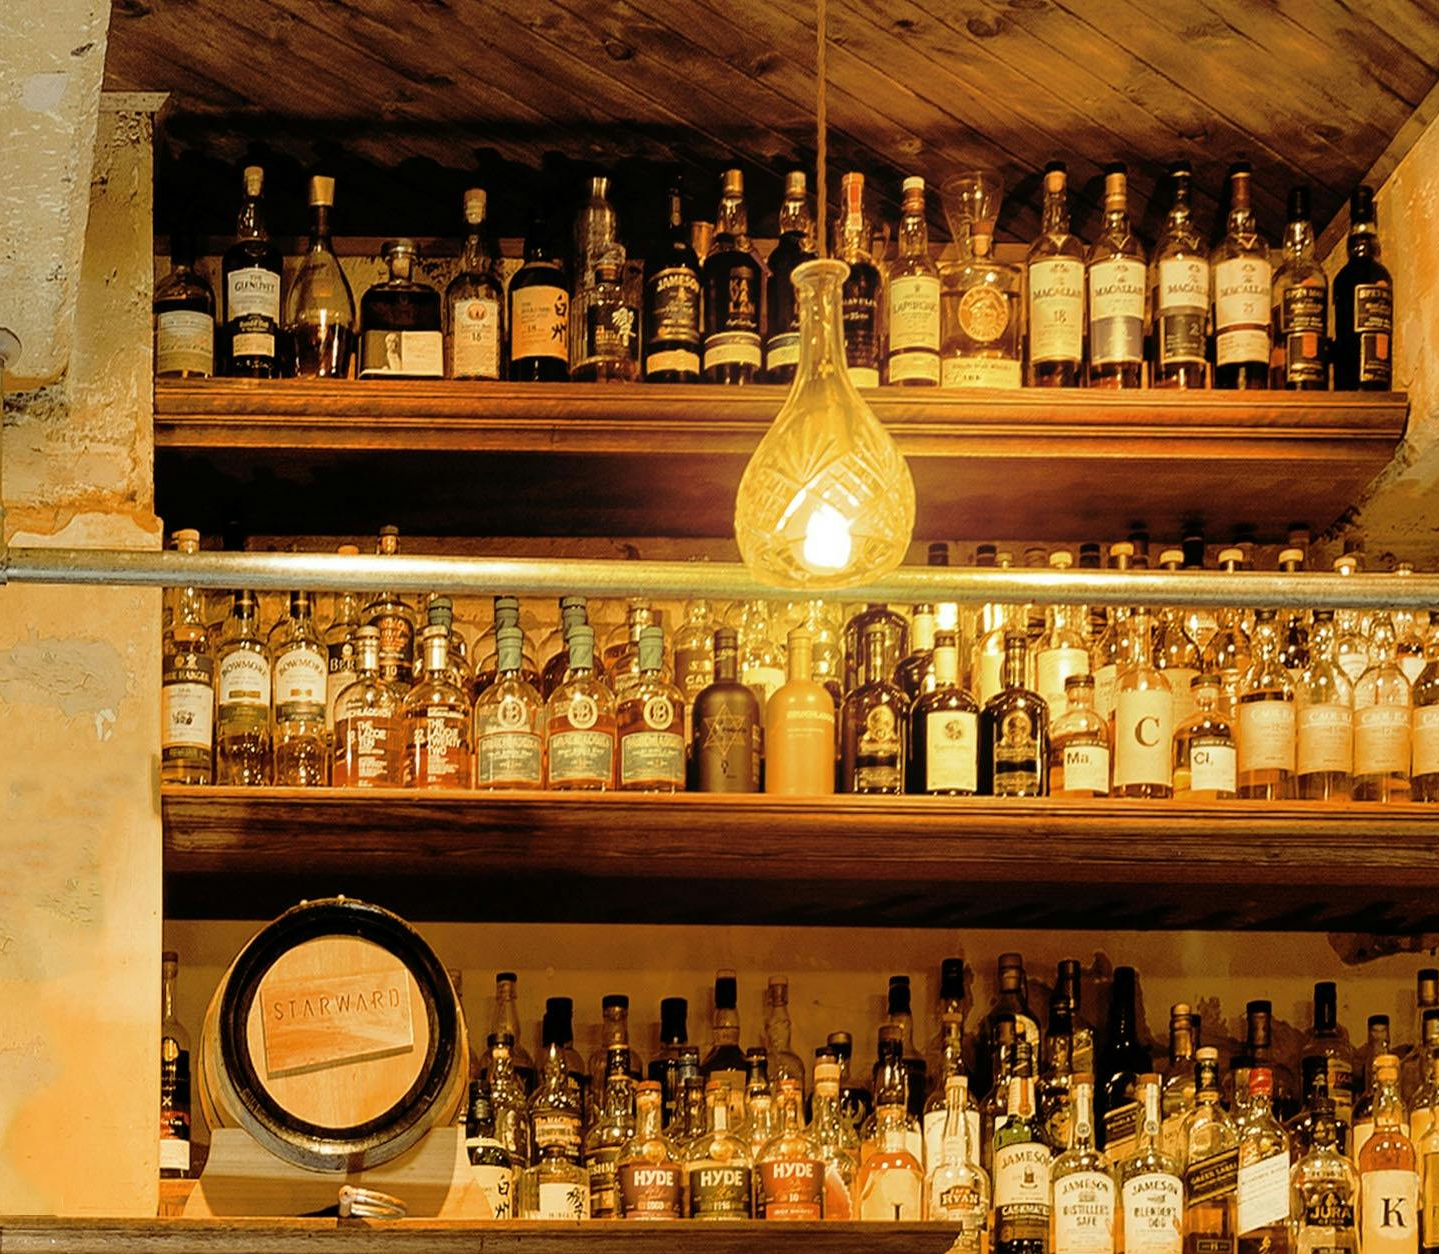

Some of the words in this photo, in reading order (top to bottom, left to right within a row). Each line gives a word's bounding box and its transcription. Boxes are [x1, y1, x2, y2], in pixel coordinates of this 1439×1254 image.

[657, 274, 700, 293] JAMESON
[730, 279, 749, 292] KA
[1134, 715, 1161, 748] C
[273, 987, 401, 1022] STARWARD
[634, 1170, 674, 1187] HYDE
[700, 1171, 744, 1187] HYDE
[774, 1162, 814, 1180] HYDE
[1062, 1180, 1109, 1196] JAMESON
[1132, 1180, 1177, 1196] JAMESON
[1310, 1204, 1352, 1221] JURA
[1379, 1197, 1408, 1229] K
